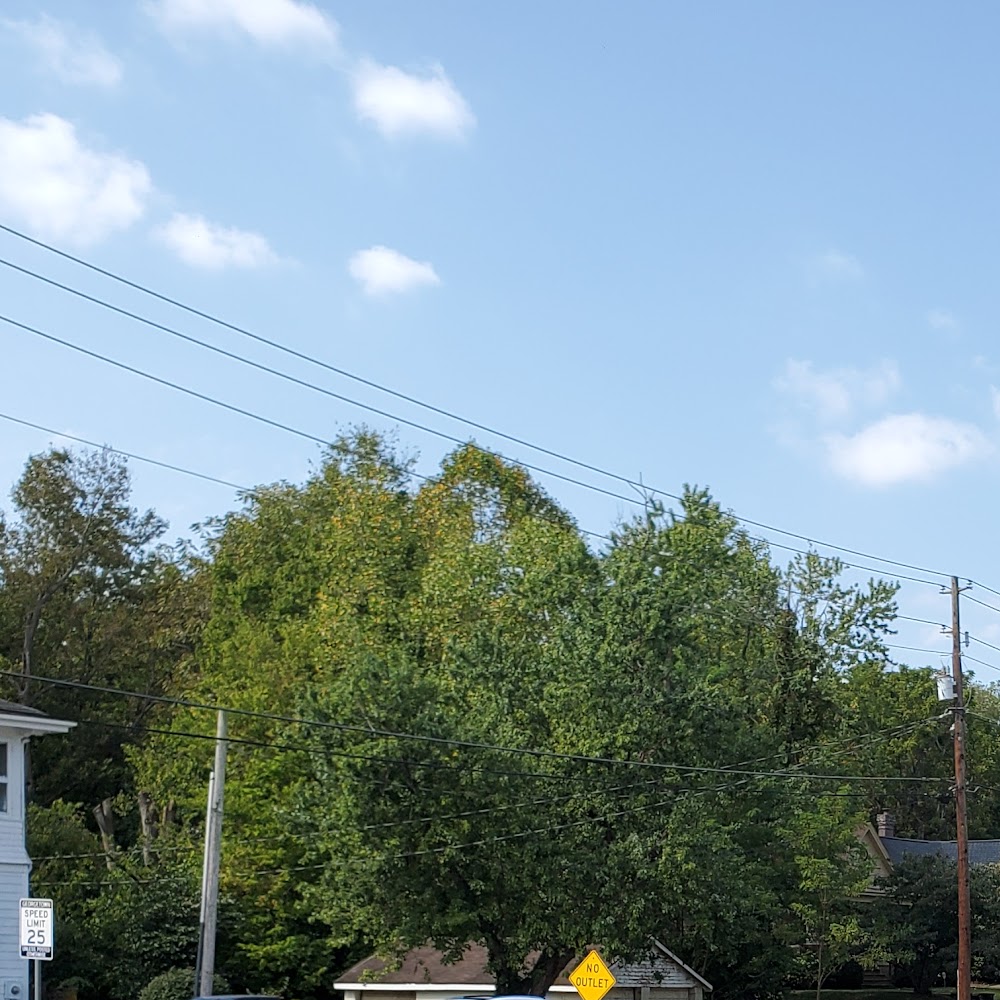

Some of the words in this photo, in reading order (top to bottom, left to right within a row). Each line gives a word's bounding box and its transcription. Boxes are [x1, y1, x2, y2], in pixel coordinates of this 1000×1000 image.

[24, 909, 48, 918] SPEED
[26, 919, 46, 928] LIMIT
[27, 929, 46, 945] 25
[586, 963, 600, 974] NO
[575, 976, 609, 988] OUTLET
